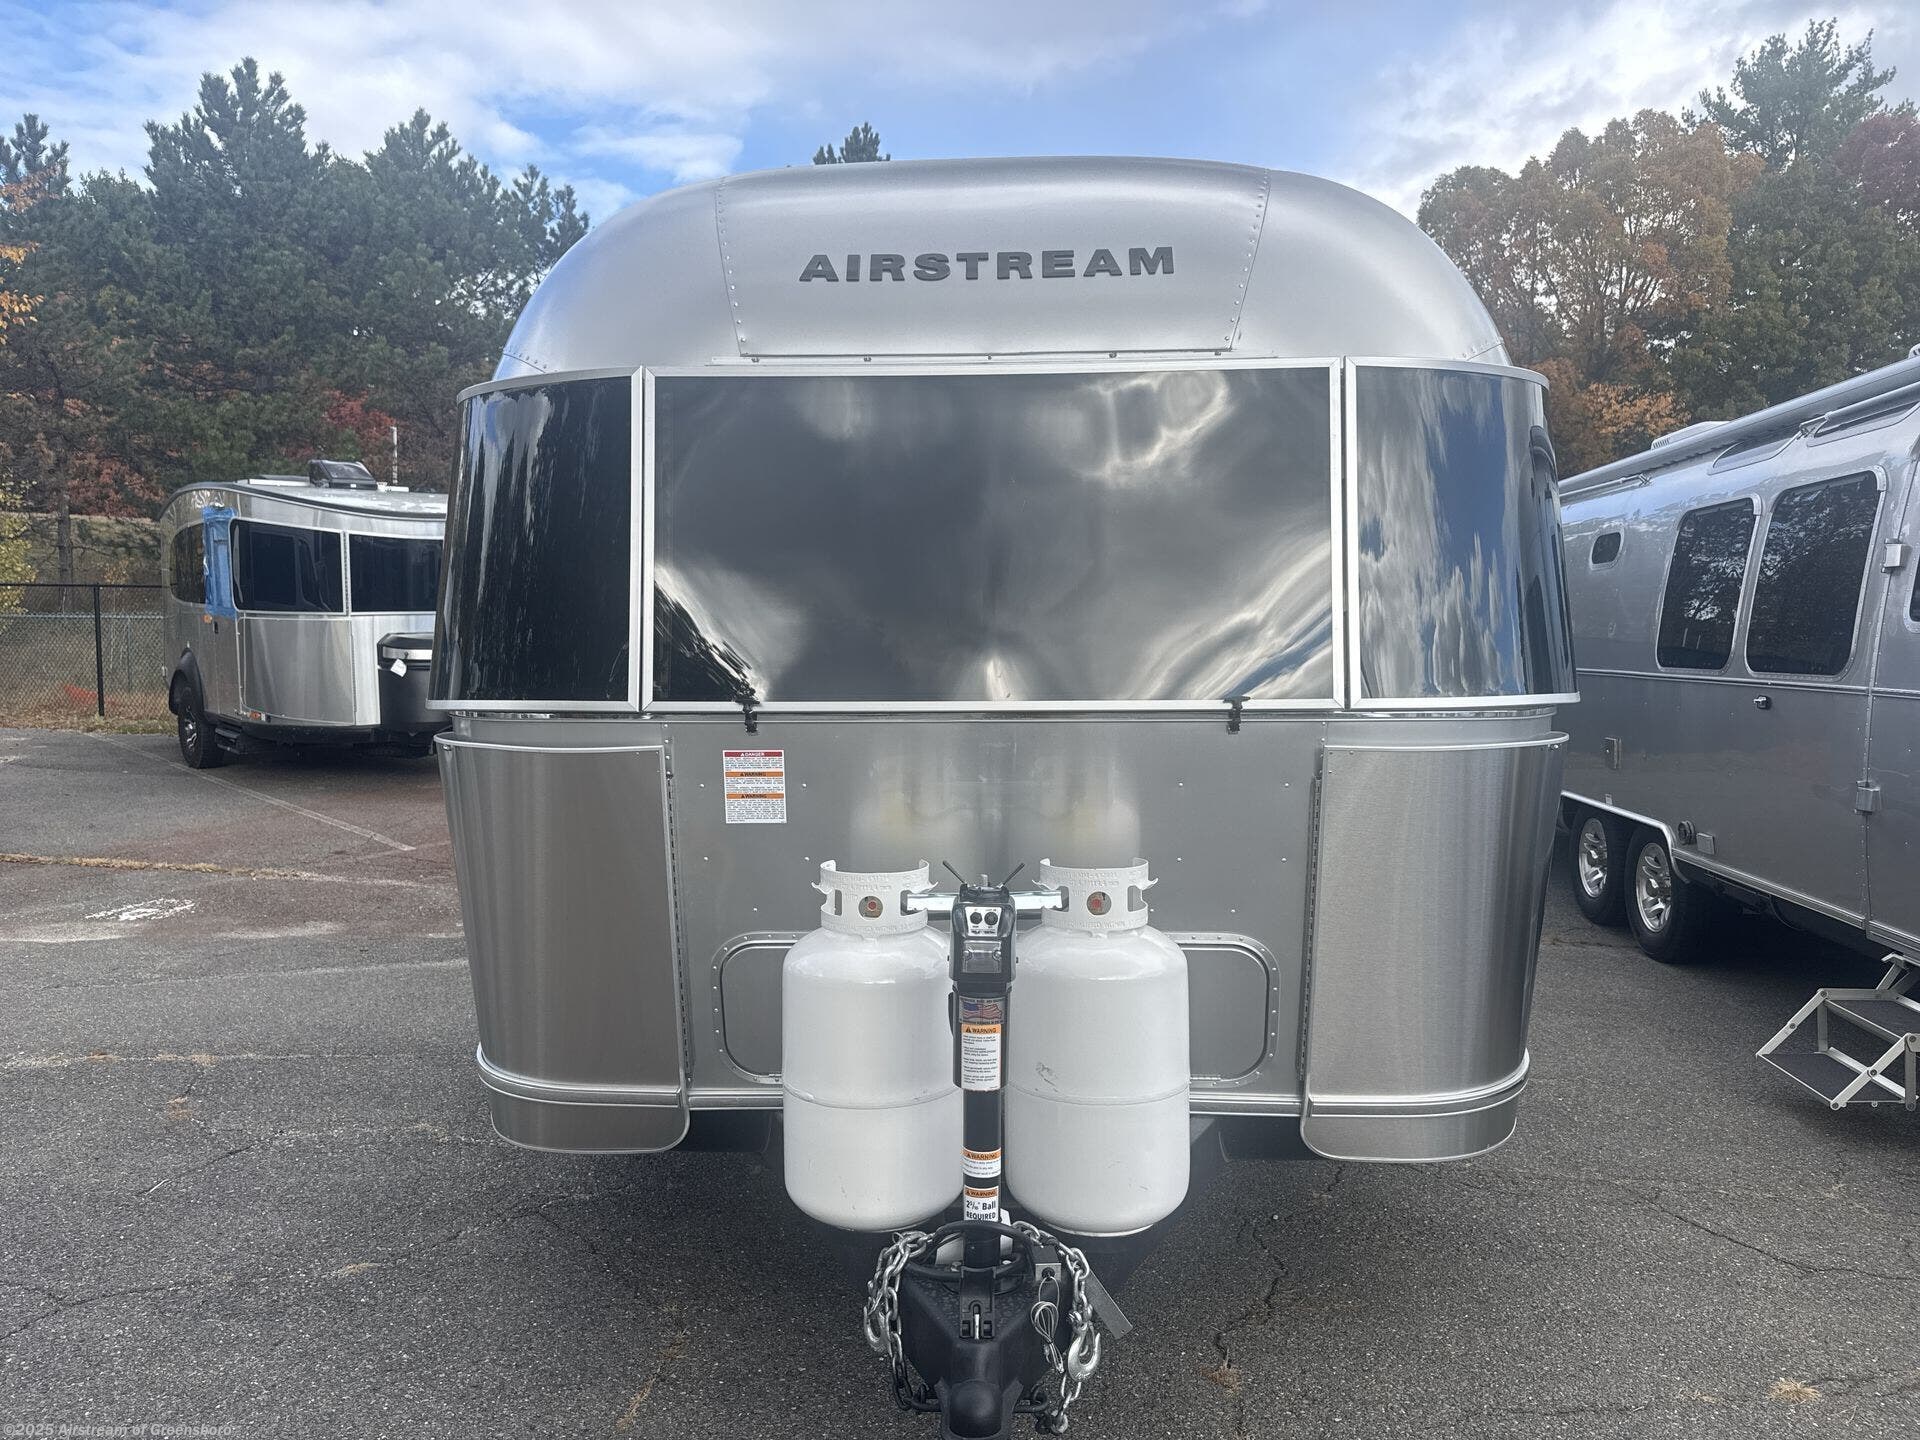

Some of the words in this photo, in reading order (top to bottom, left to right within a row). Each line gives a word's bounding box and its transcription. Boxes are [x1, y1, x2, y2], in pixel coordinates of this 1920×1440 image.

[799, 246, 1174, 282] AIRSTREAM
[971, 1152, 997, 1160] WARNING
[982, 1200, 996, 1210] Ball
[966, 1211, 996, 1221] REQUIRED
